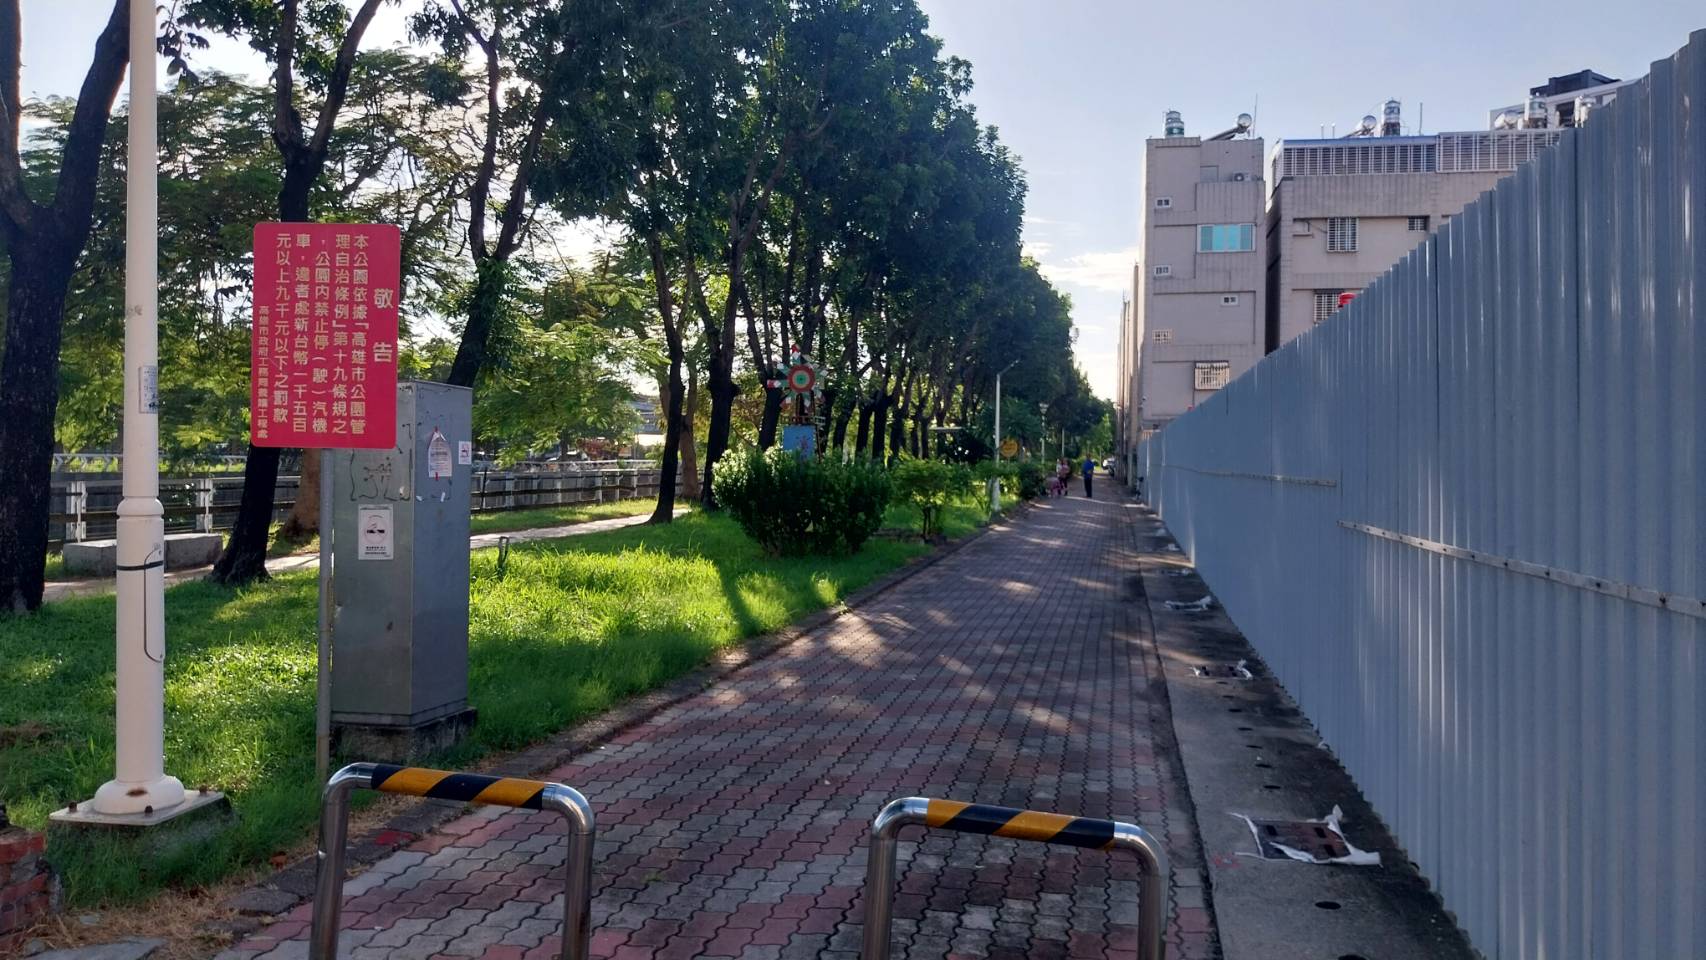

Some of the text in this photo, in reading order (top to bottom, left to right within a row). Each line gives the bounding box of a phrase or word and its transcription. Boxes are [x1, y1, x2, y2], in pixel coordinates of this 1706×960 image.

[273, 233, 291, 424] 元以上九千元以下之罰款
[373, 289, 394, 363] 敬告
